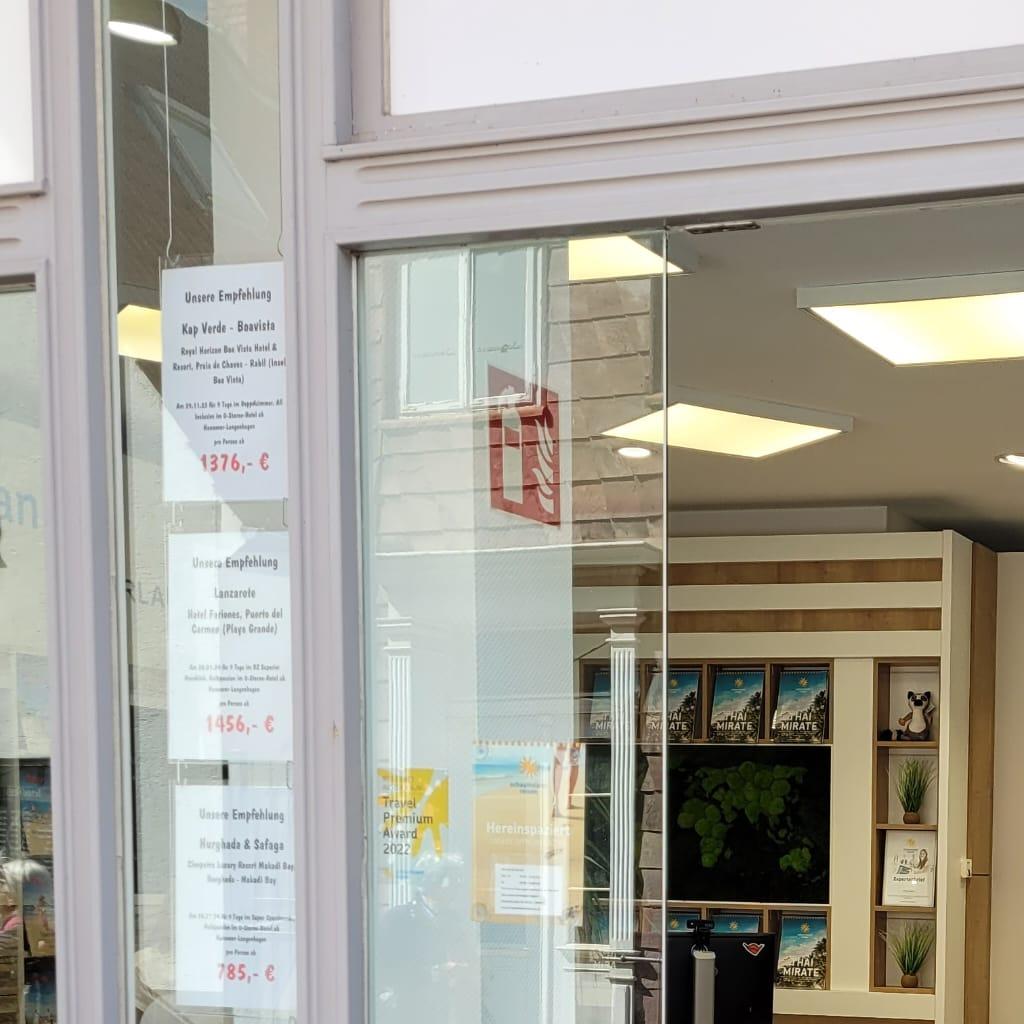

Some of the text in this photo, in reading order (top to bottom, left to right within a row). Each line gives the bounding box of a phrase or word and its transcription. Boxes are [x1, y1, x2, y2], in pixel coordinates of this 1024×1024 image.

[185, 287, 272, 305] Unsere Empfehlung
[182, 323, 198, 338] Kap
[202, 320, 226, 335] Verde
[237, 319, 276, 333] Boavista
[254, 342, 270, 352] Hotel
[200, 452, 270, 474] 1376,- €
[192, 554, 279, 572] Unsere Empfehlung
[214, 587, 256, 599] Lanzarote
[207, 714, 274, 736] 1456,- €
[383, 796, 417, 809] Travel
[199, 807, 285, 824] Unsere Empfehlung
[383, 812, 434, 824] Premium
[383, 826, 418, 839] Award
[199, 837, 285, 854] Hurghada & Safaga
[383, 843, 411, 855] 2022
[218, 963, 275, 984] 785,- €
